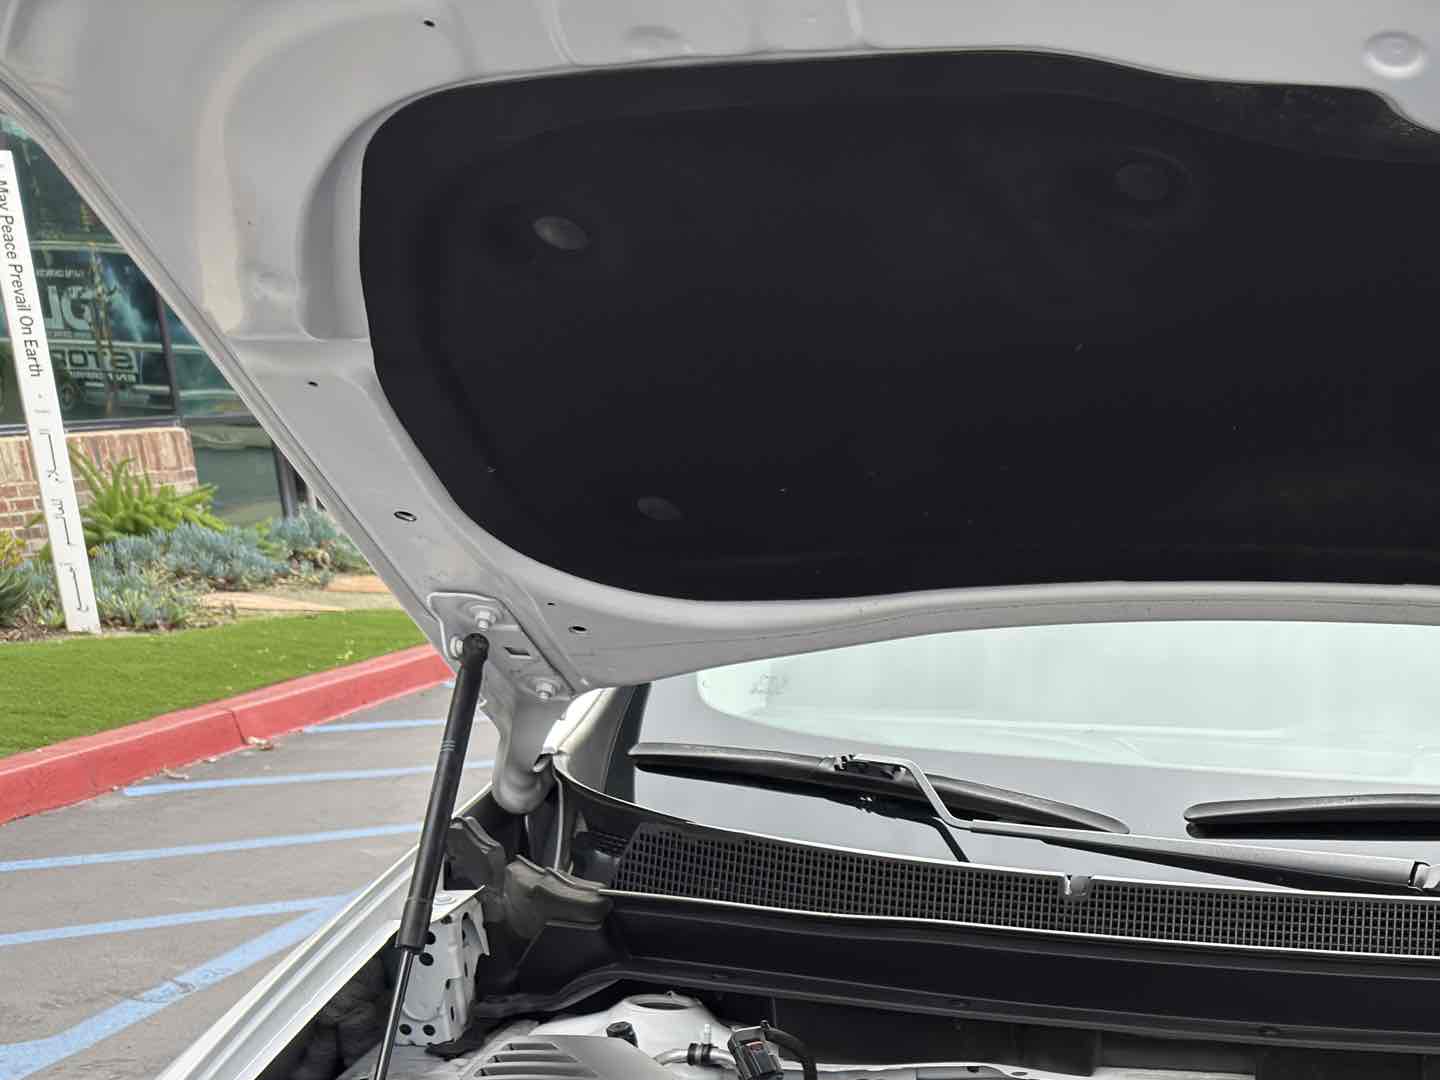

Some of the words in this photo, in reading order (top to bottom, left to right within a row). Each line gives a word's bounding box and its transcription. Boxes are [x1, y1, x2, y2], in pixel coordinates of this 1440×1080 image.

[0, 215, 17, 260] Peace
[8, 263, 31, 311] Prevail
[19, 315, 34, 335] On
[24, 339, 44, 377] Earth
